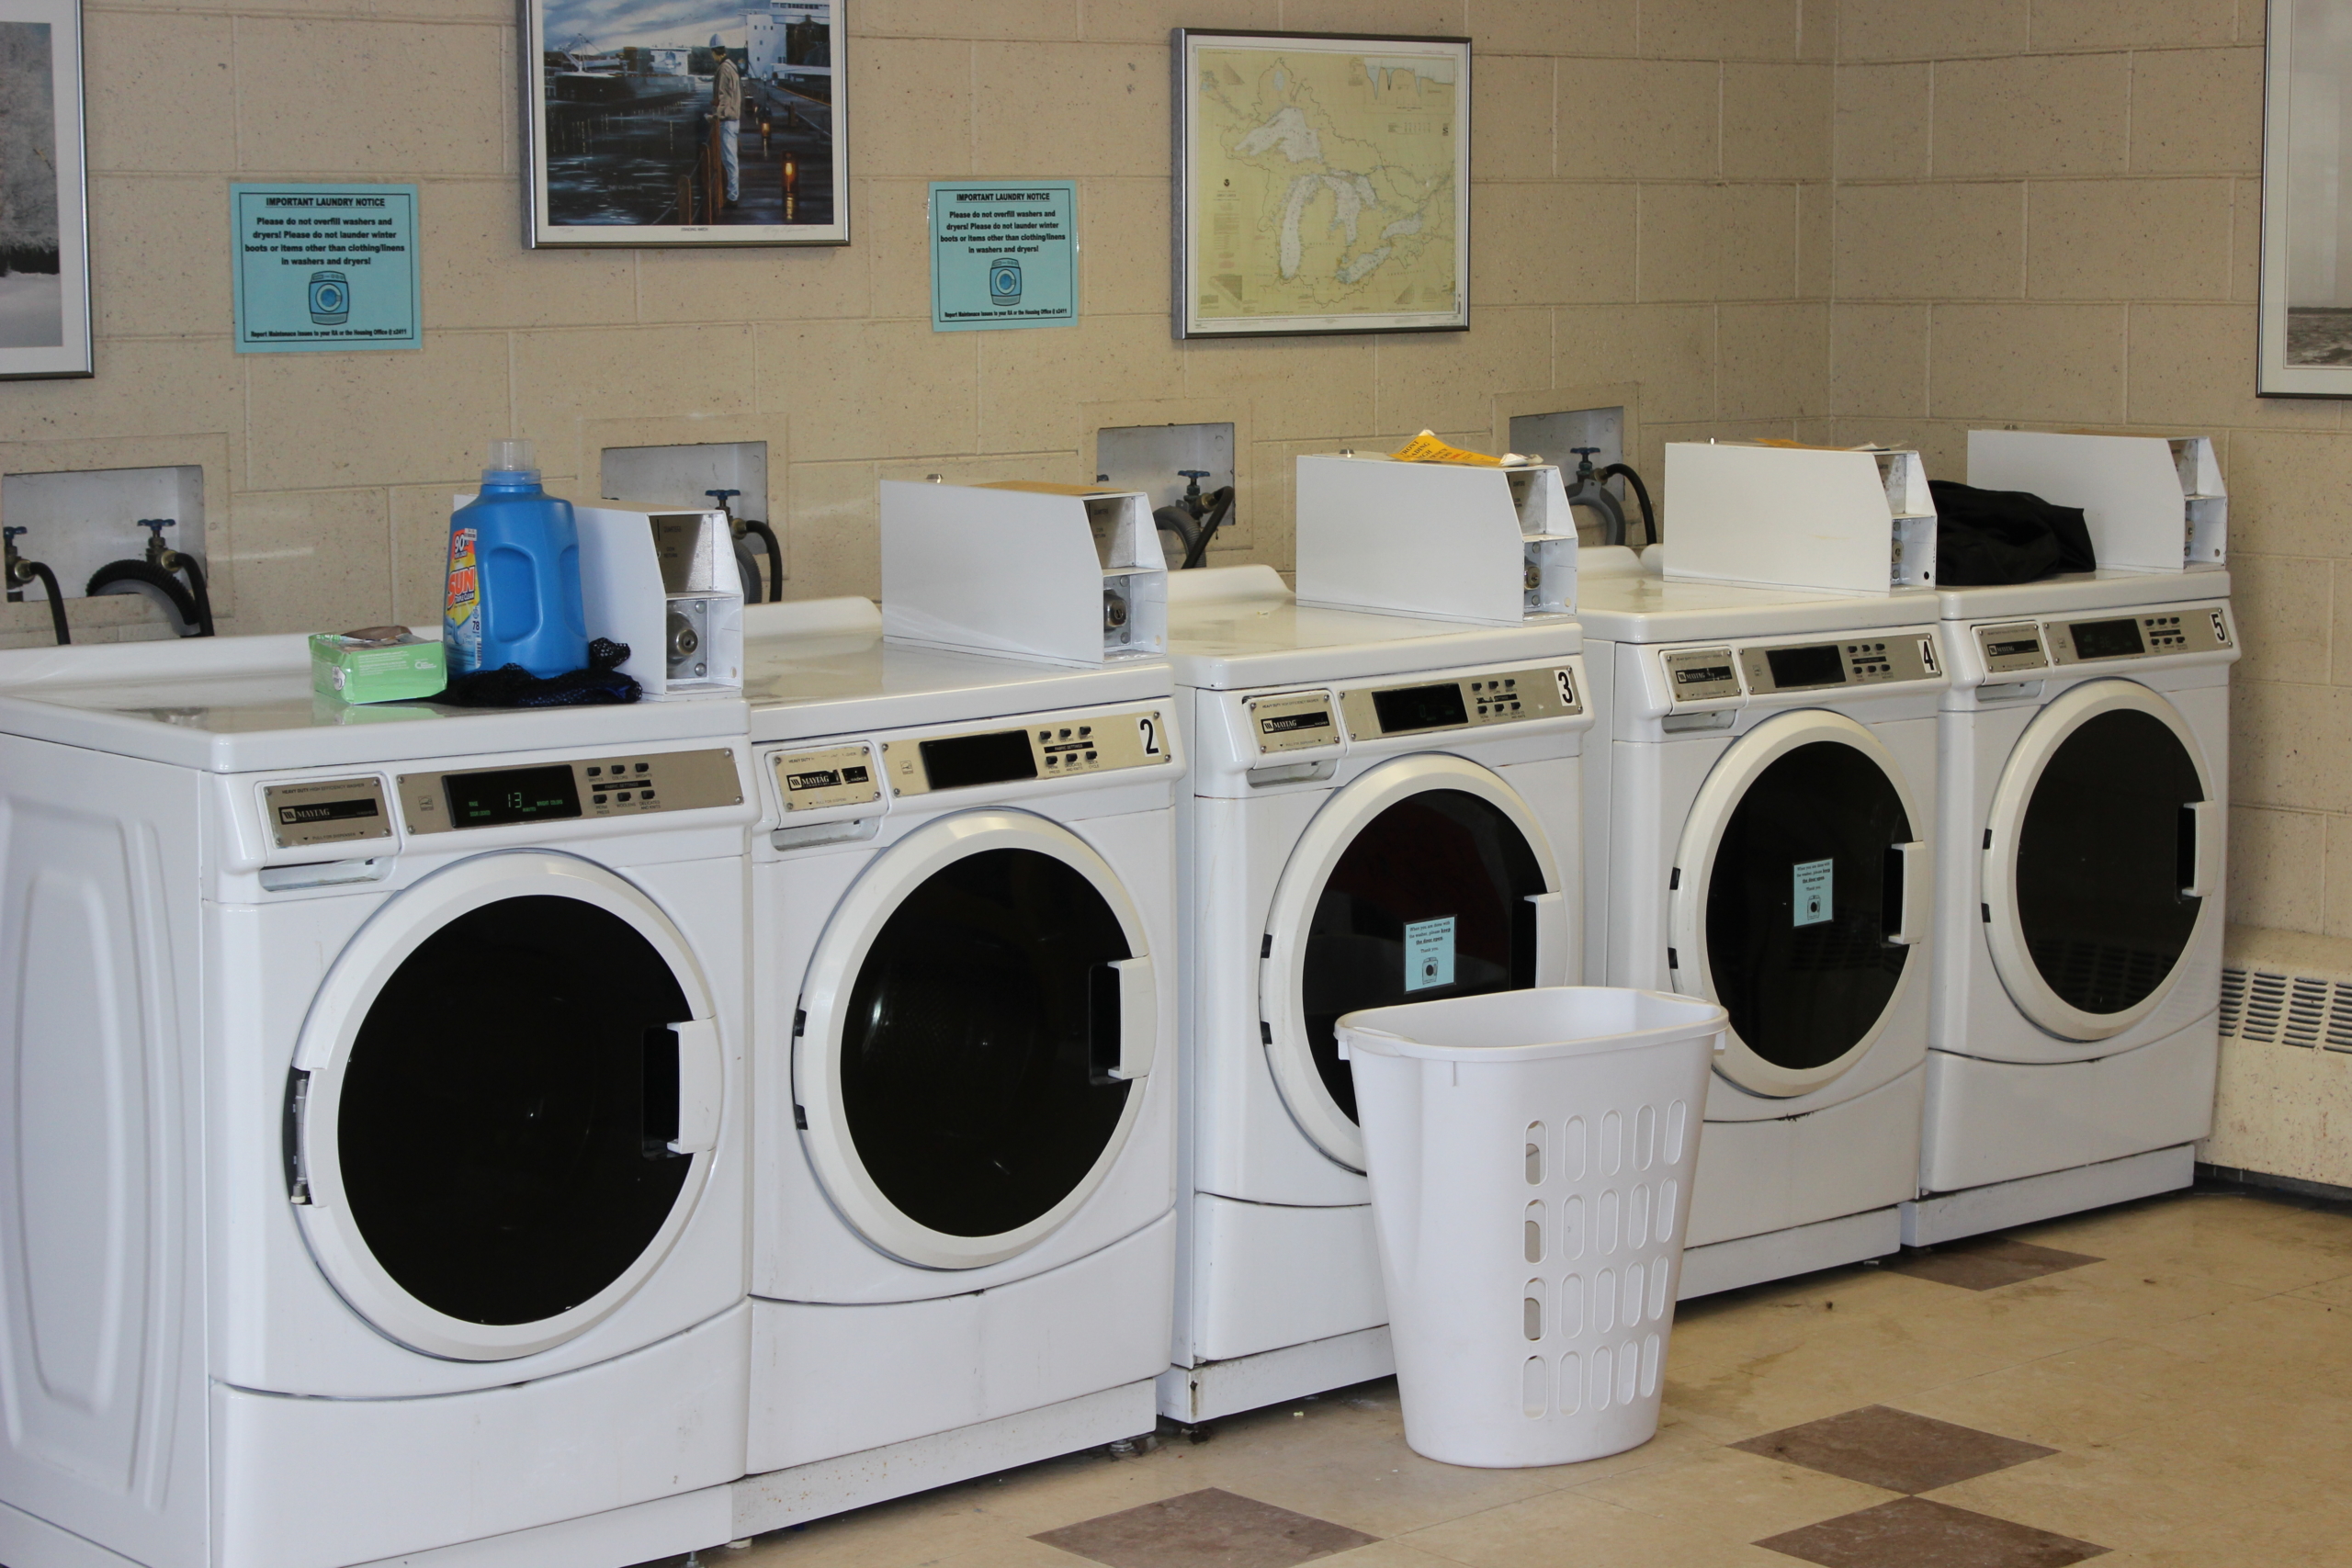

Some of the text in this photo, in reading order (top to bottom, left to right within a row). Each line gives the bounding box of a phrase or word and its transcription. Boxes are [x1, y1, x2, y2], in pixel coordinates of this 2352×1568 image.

[266, 198, 385, 207] IMPORTANT LAUNDRY NOTICE
[946, 223, 968, 231] dryers!
[253, 231, 281, 240] dryers!
[348, 244, 404, 253] clothing/linens
[344, 258, 371, 266] dryers!
[447, 566, 475, 610] SUN
[472, 621, 480, 630] 78
[2211, 613, 2225, 641] 5
[1923, 640, 1935, 671] 4
[1556, 671, 1574, 704] 3
[1138, 718, 1159, 755] 2
[802, 776, 829, 784] MAYTAG
[508, 792, 522, 807] 13
[297, 808, 330, 818] MAYTAG
